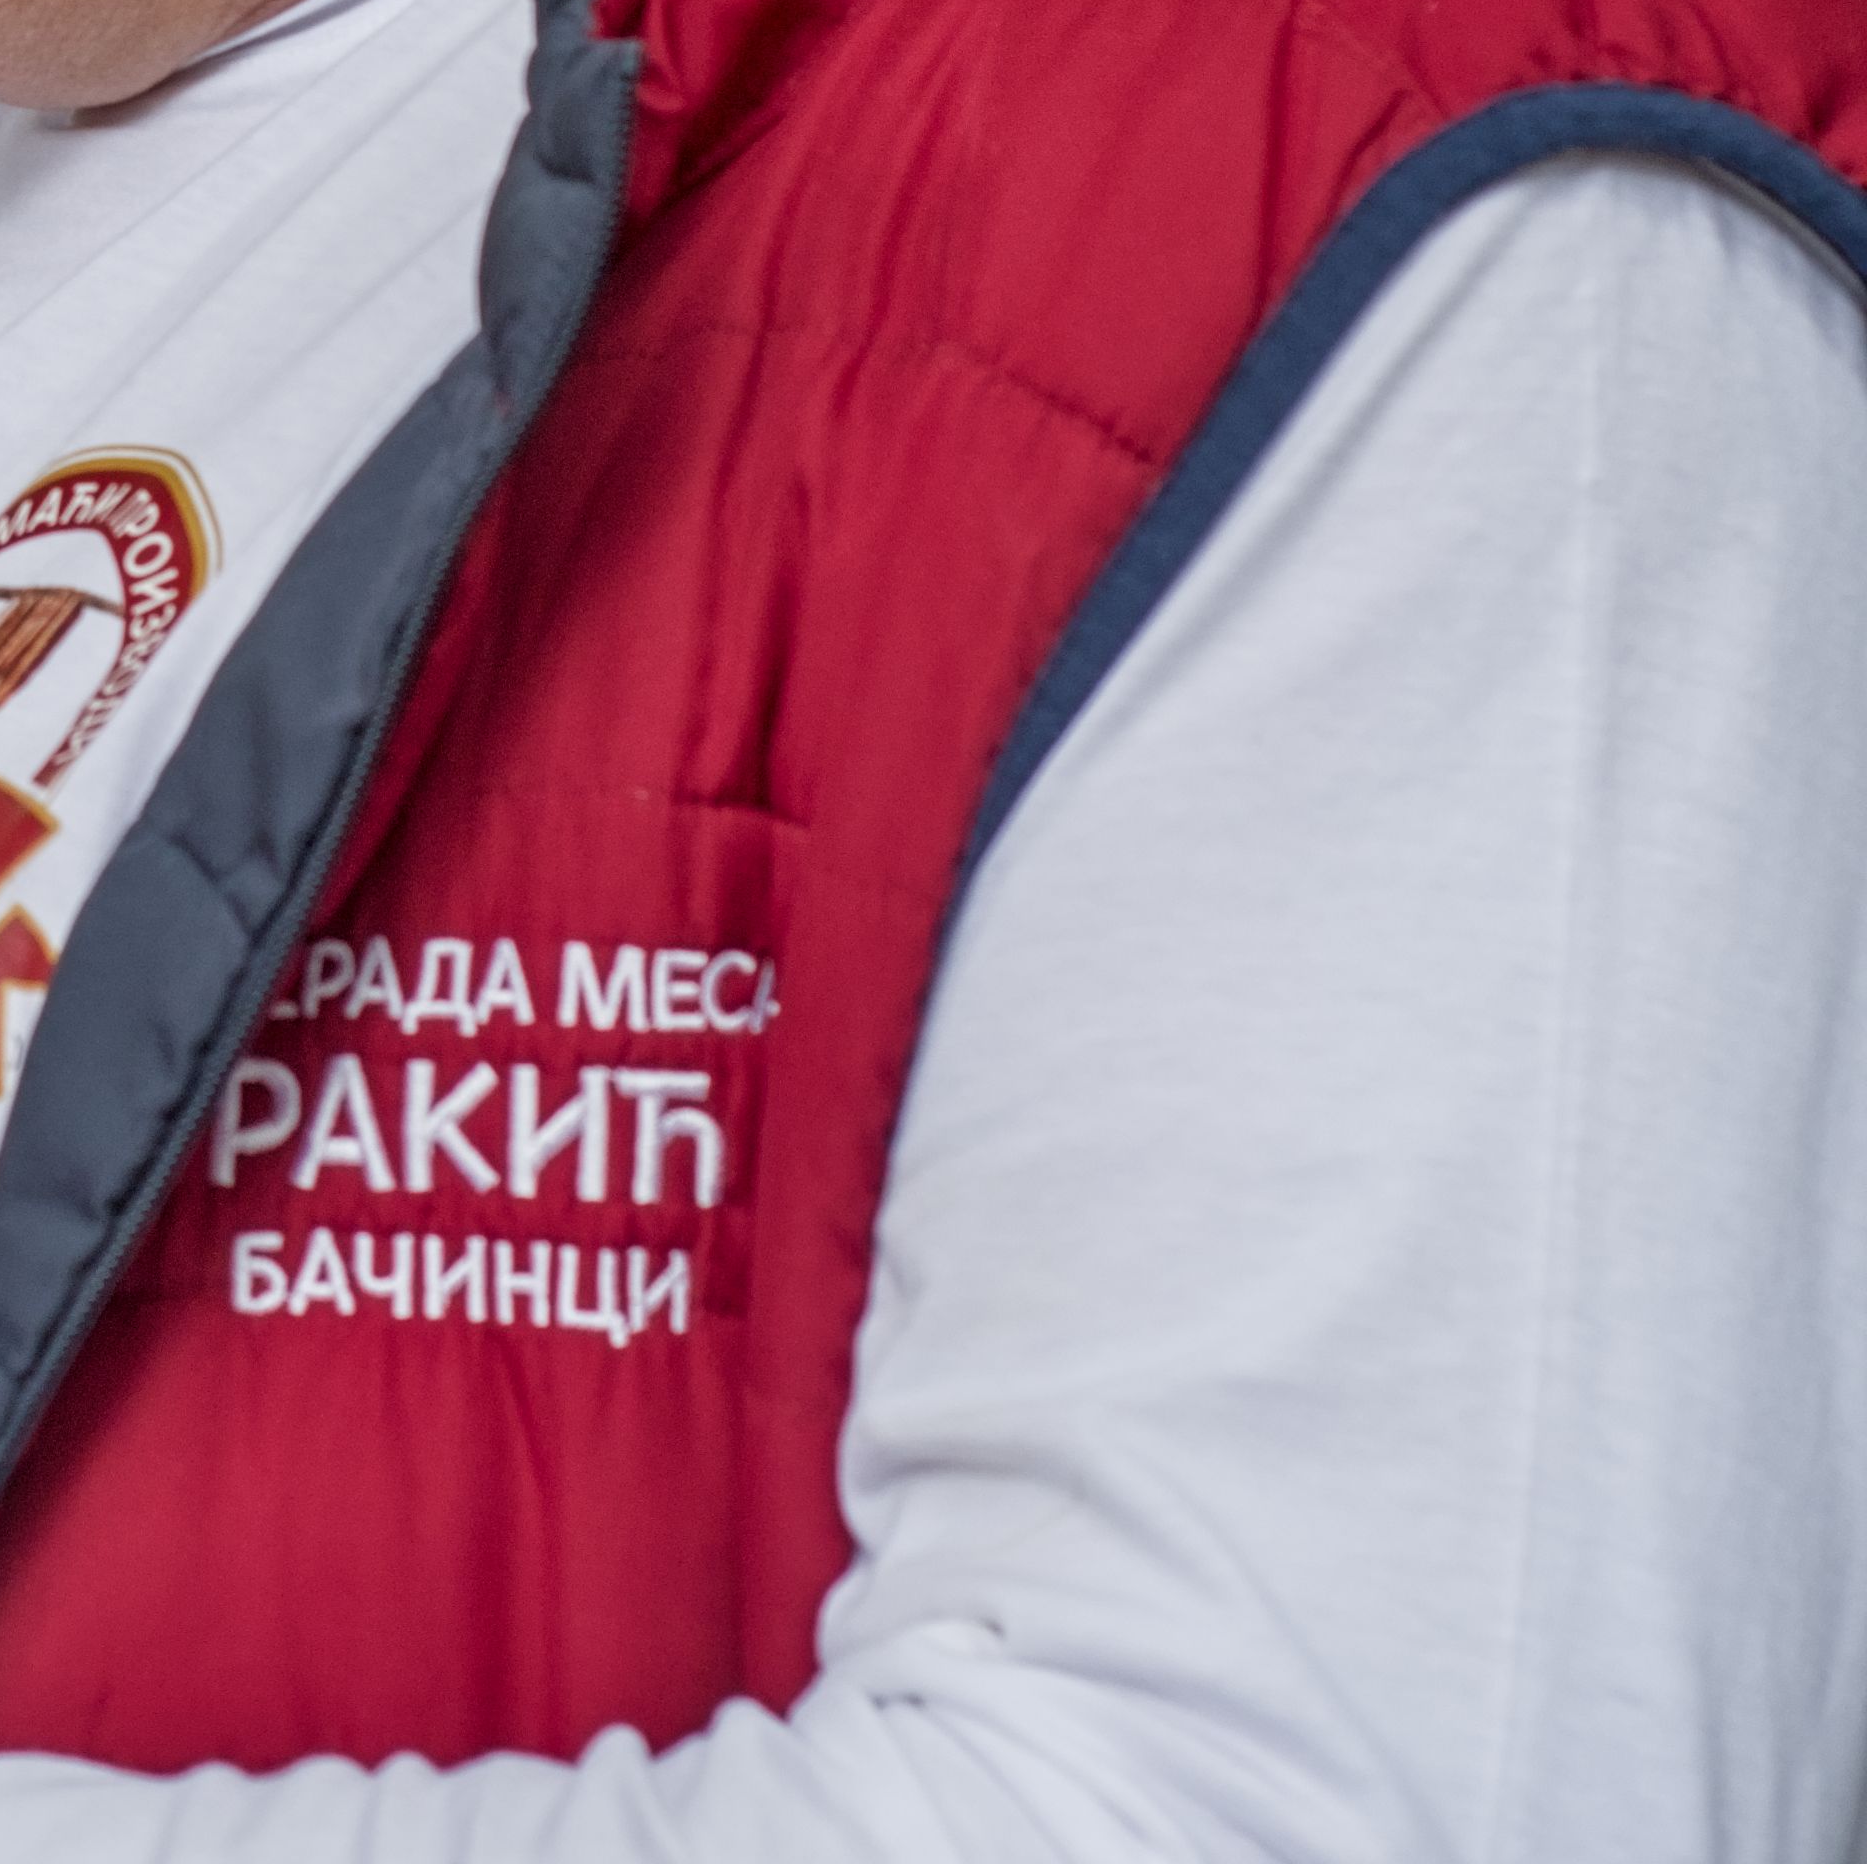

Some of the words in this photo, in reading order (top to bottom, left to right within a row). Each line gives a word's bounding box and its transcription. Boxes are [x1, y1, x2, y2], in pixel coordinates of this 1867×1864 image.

[270, 935, 535, 1036] РАДА
[210, 1053, 724, 1207] РАКИЋ
[230, 1227, 692, 1349] БАЧИНЦИ
